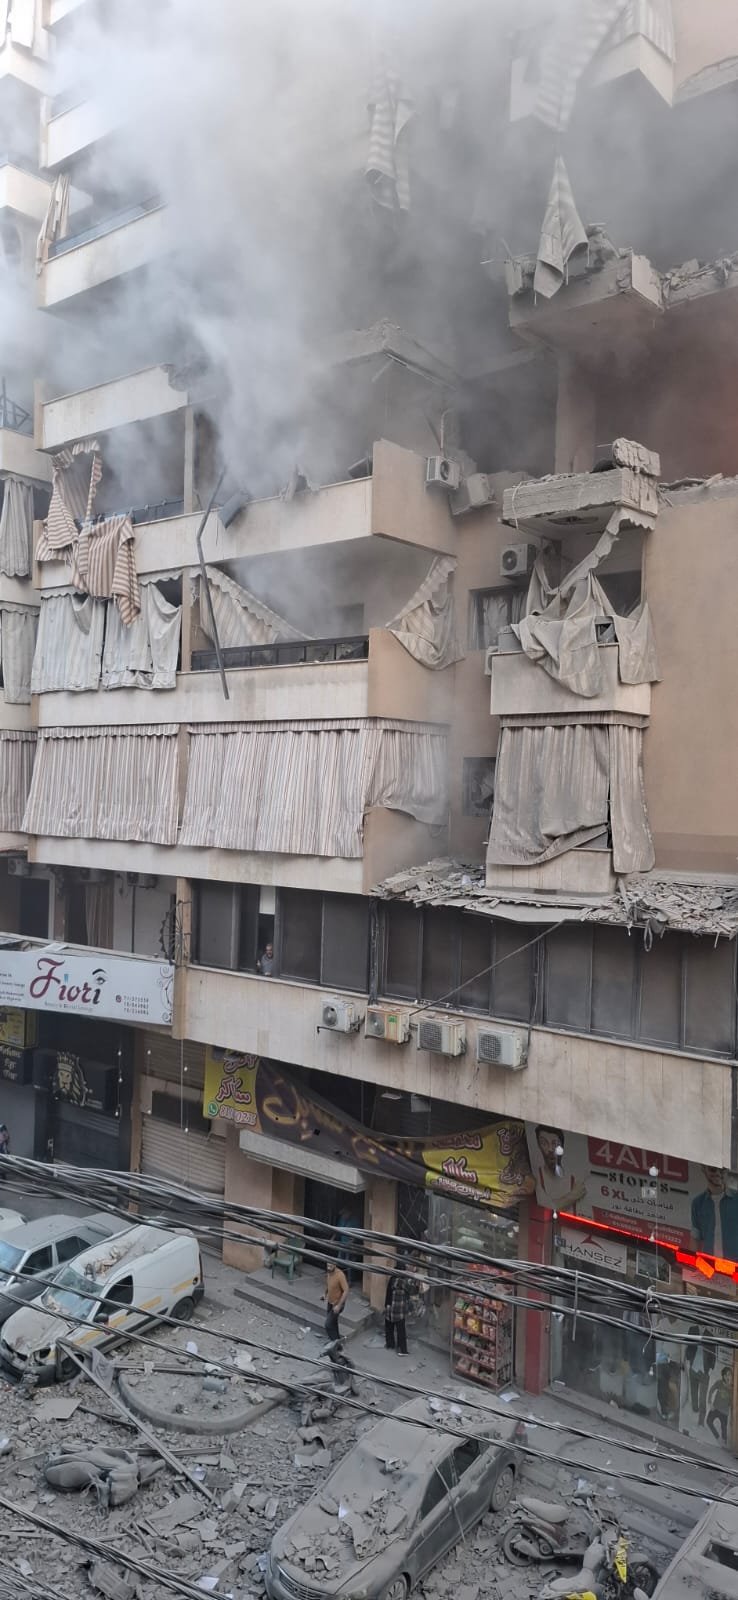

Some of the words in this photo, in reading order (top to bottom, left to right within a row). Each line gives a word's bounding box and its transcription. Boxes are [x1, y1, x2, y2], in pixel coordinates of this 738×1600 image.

[30, 957, 101, 1005] Fiori
[596, 1141, 682, 1177] 4ALL
[600, 1185, 610, 1197] 6
[612, 1189, 630, 1202] XL
[609, 1172, 669, 1194] stores
